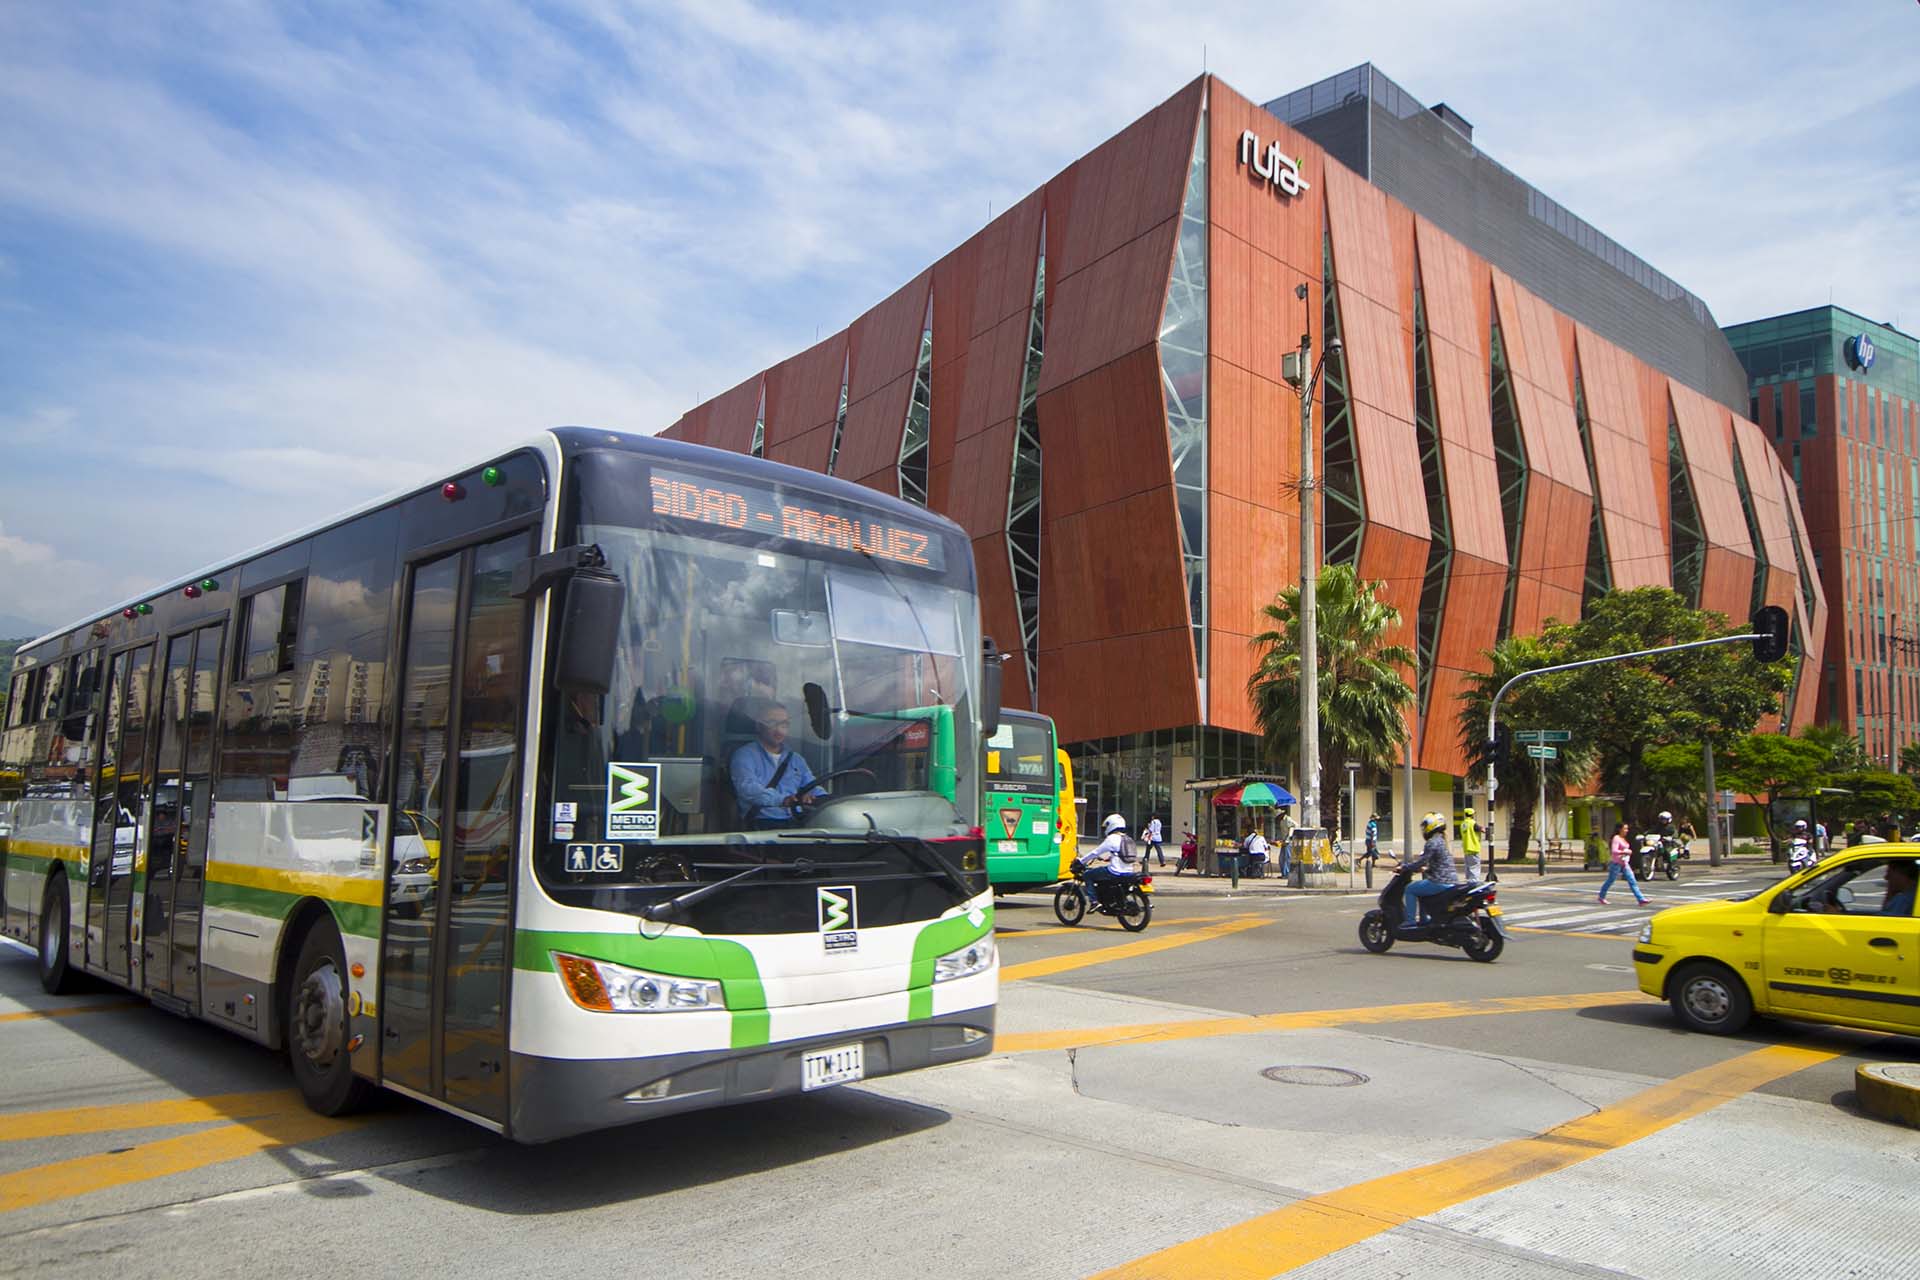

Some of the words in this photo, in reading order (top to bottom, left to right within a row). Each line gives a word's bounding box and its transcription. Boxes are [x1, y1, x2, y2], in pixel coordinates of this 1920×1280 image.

[1858, 332, 1874, 367] hp
[650, 475, 748, 529] SIDAD
[782, 505, 929, 565] ARANJUEZ
[611, 815, 655, 824] METRO
